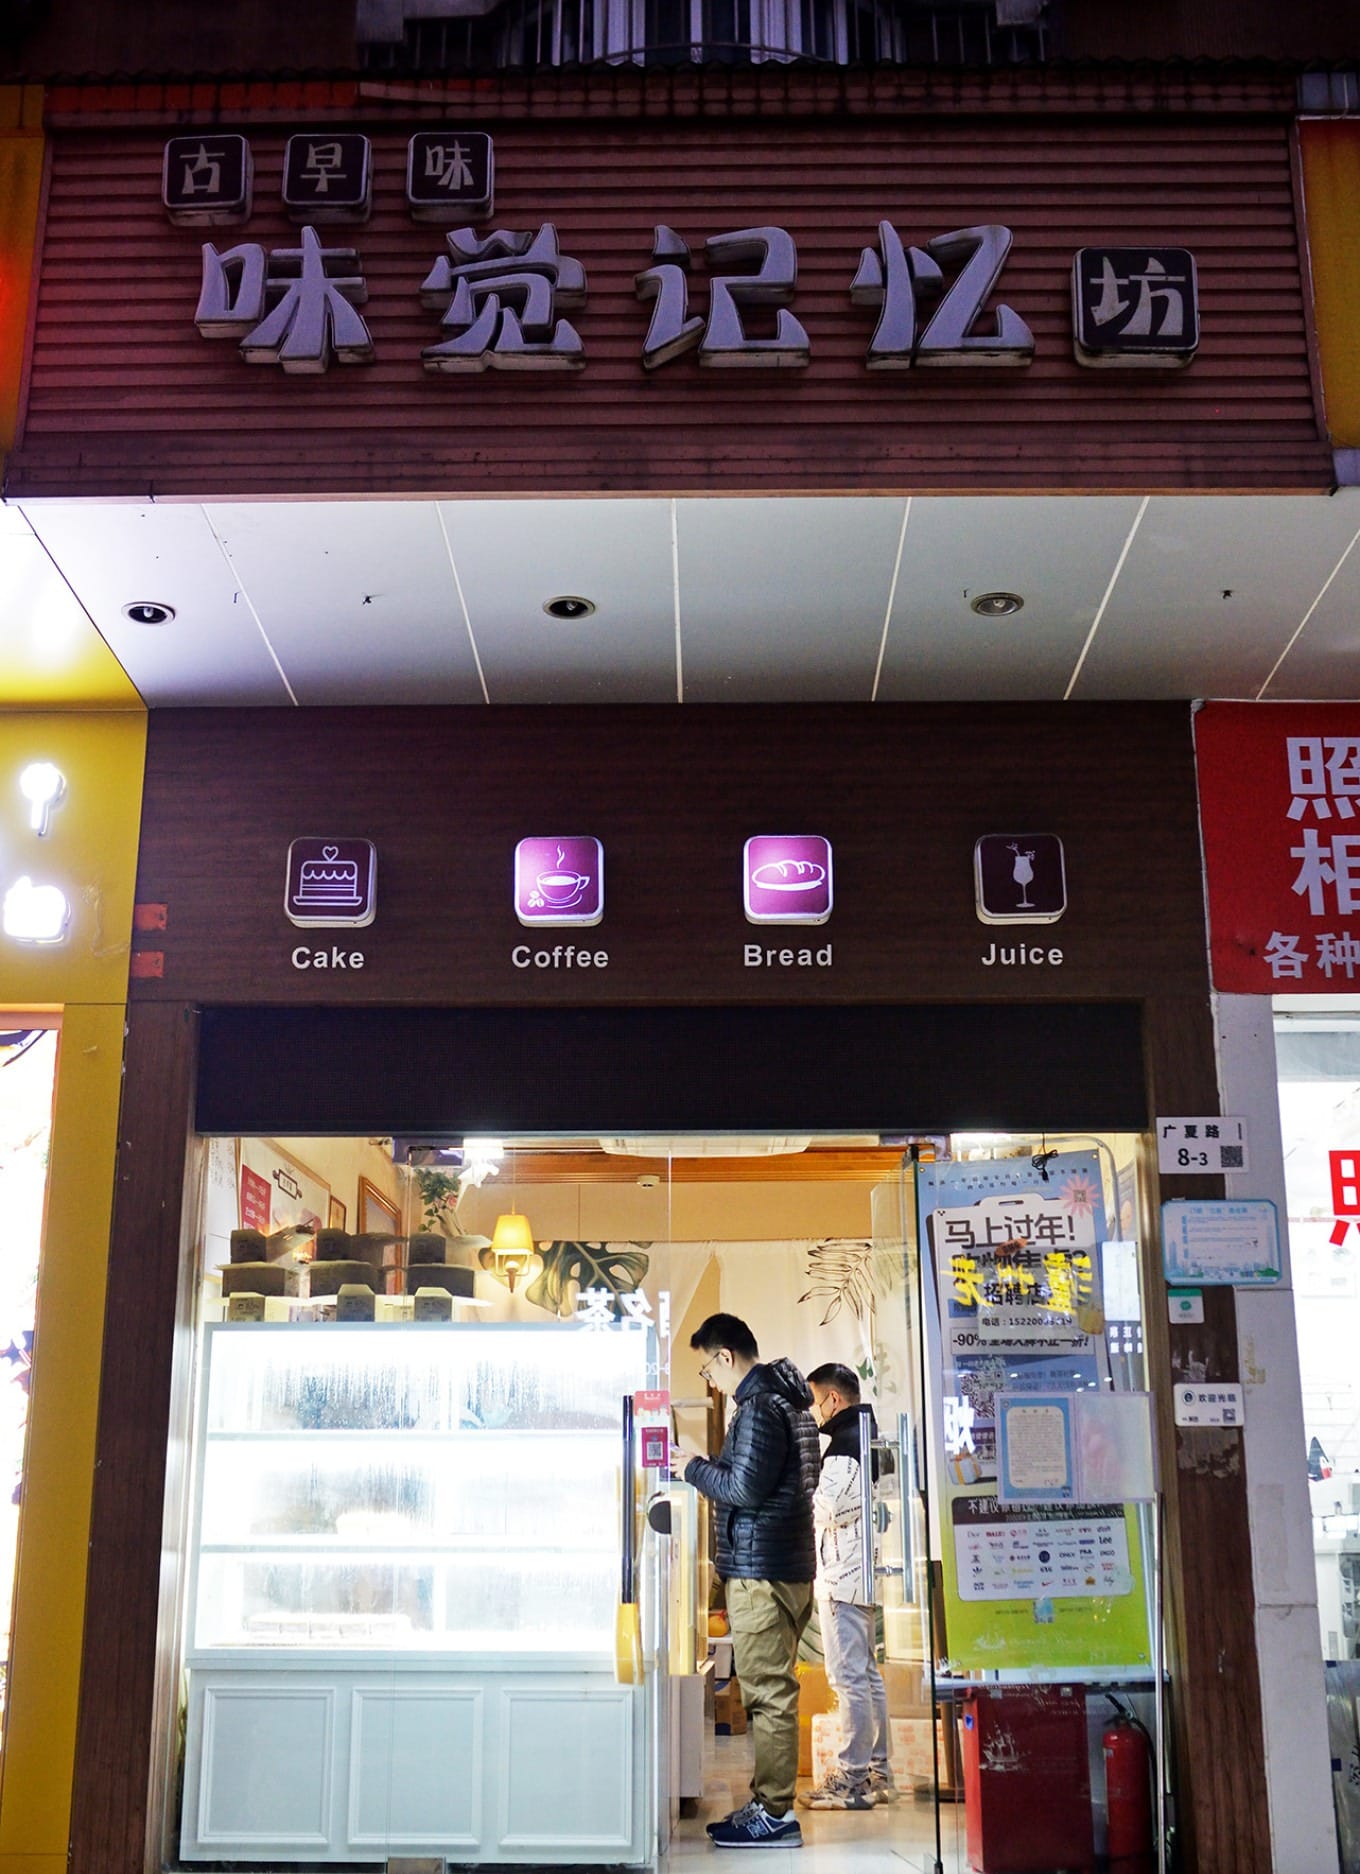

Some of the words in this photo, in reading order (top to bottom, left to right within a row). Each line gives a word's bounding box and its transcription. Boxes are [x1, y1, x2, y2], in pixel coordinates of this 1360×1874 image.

[180, 142, 474, 196] 古早味
[291, 946, 365, 969] Cake
[511, 945, 609, 968] Coffee
[743, 943, 833, 967] Bread
[981, 942, 1064, 966] Juice
[1177, 1148, 1209, 1166] 8-3
